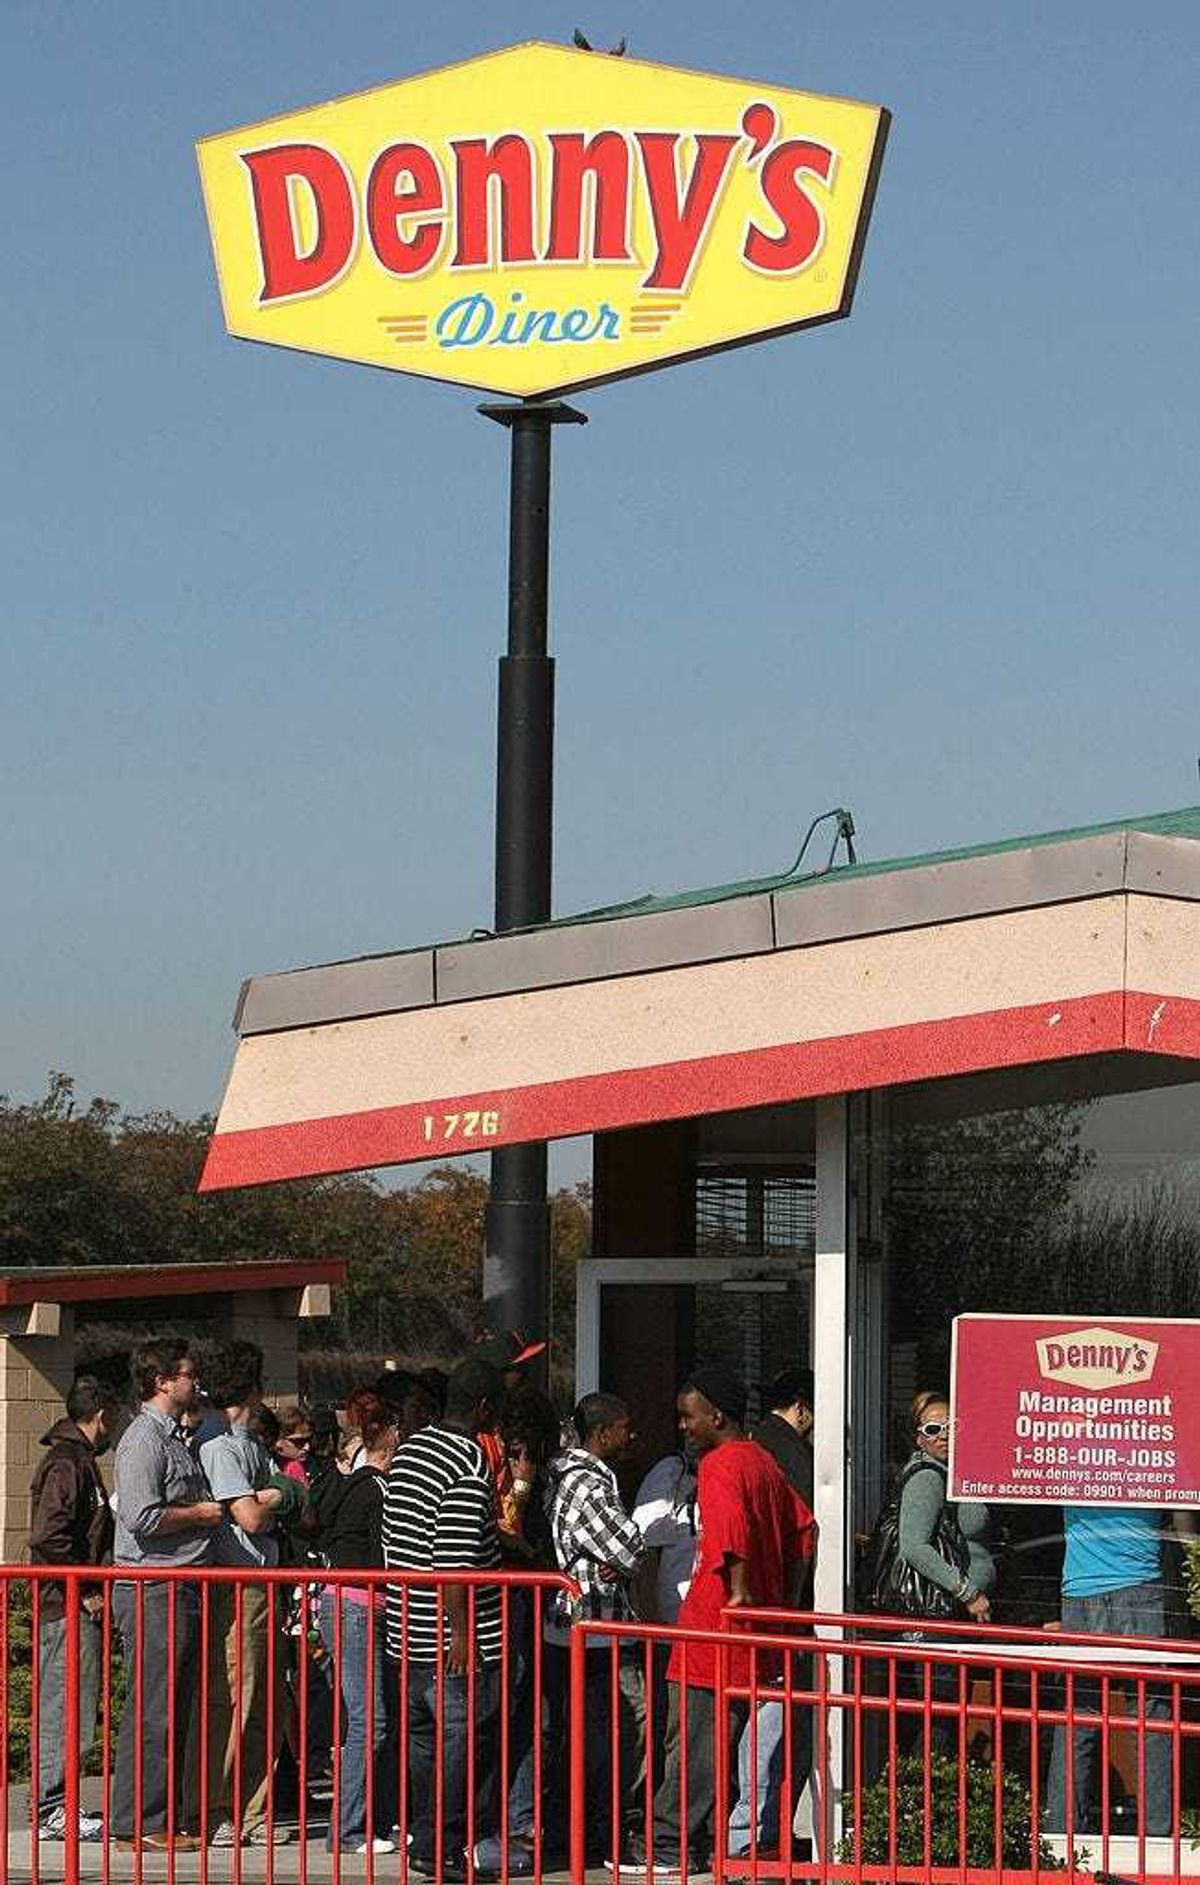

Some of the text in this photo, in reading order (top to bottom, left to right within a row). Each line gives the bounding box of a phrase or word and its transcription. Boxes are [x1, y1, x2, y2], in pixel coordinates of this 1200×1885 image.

[240, 102, 836, 303] Denny's
[434, 292, 622, 349] Diner
[1045, 1343, 1149, 1374] Denny's
[1018, 1391, 1172, 1418] Management
[1015, 1415, 1175, 1442] Opportunities
[1013, 1447, 1176, 1467] 1-888-OUR-JOBS
[1011, 1467, 1176, 1484] www.dennys.com/careers
[962, 1480, 1200, 1502] Enter access code: 09901 when prom
